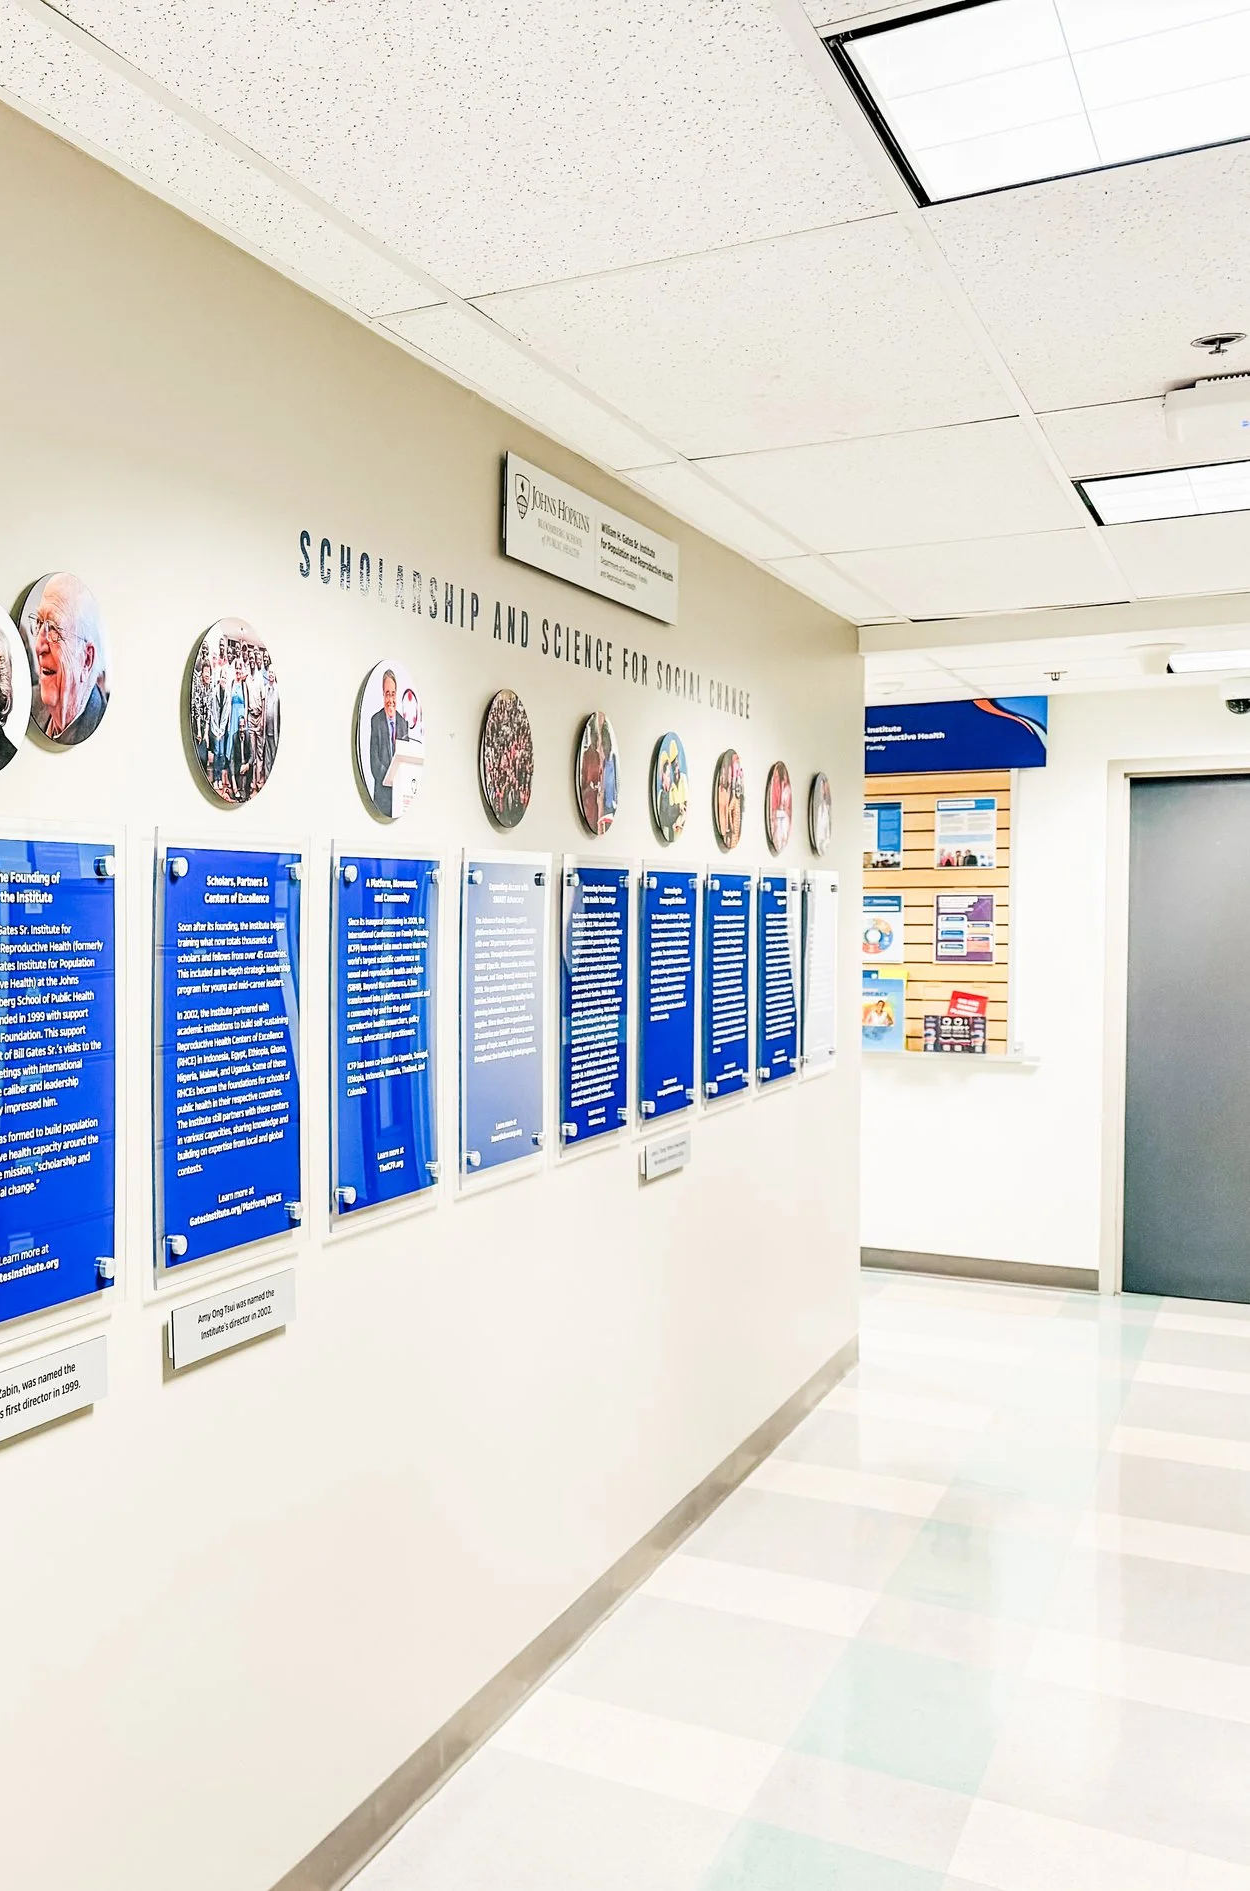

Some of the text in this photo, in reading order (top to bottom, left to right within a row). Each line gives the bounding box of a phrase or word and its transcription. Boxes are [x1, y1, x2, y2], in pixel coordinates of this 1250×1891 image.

[531, 486, 590, 533] JOHNS HOPKINS
[600, 522, 616, 539] William
[622, 533, 633, 547] Gates
[640, 542, 655, 558] Institute
[608, 542, 629, 560] Population
[638, 556, 661, 576] Reproductive
[662, 570, 673, 582] Health
[299, 530, 751, 720] SCHOLARSHIP AND SCIENCE FOR SOCIAL CHANGE
[918, 732, 945, 740] Health
[10, 870, 50, 884] Founding
[51, 871, 60, 884] of
[206, 875, 236, 887] Scholars,
[236, 877, 263, 887] Partners
[0, 891, 53, 903] the Institute
[204, 893, 230, 904] Centers
[238, 893, 270, 904] Excellence
[19, 925, 29, 935] Sr.
[31, 925, 60, 935] Institute
[61, 924, 71, 934] for
[0, 943, 48, 954] Reproductive
[49, 941, 72, 952] Health
[73, 940, 103, 951] (formerly
[17, 960, 47, 971] Institute
[48, 959, 58, 969] for
[59, 958, 95, 968] Population
[10, 977, 37, 989] Health)
[37, 977, 45, 987] at
[46, 976, 58, 987] the
[59, 976, 79, 986] Johns
[17, 994, 42, 1006] School
[42, 993, 50, 1004] of
[51, 992, 72, 1003] Public
[73, 990, 95, 1002] Health
[0, 1030, 43, 1043] Foundation.
[45, 1027, 59, 1038] This
[60, 1026, 86, 1037] support
[178, 1101, 289, 1130] The Institute still partners with these centers
[177, 1164, 203, 1177] contexts.
[218, 1192, 234, 1204] Learn
[234, 1189, 248, 1199] more
[21, 1248, 40, 1260] more
[41, 1244, 49, 1255] at
[198, 1288, 275, 1324] Amy Ong Tsui was named the
[201, 1306, 273, 1340] Institute's director in 2002.
[22, 1378, 36, 1391] was
[38, 1368, 63, 1385] named
[64, 1362, 76, 1375] the
[5, 1401, 21, 1417] first
[22, 1392, 51, 1410] director
[53, 1388, 60, 1398] in
[62, 1380, 82, 1396] 1999.
